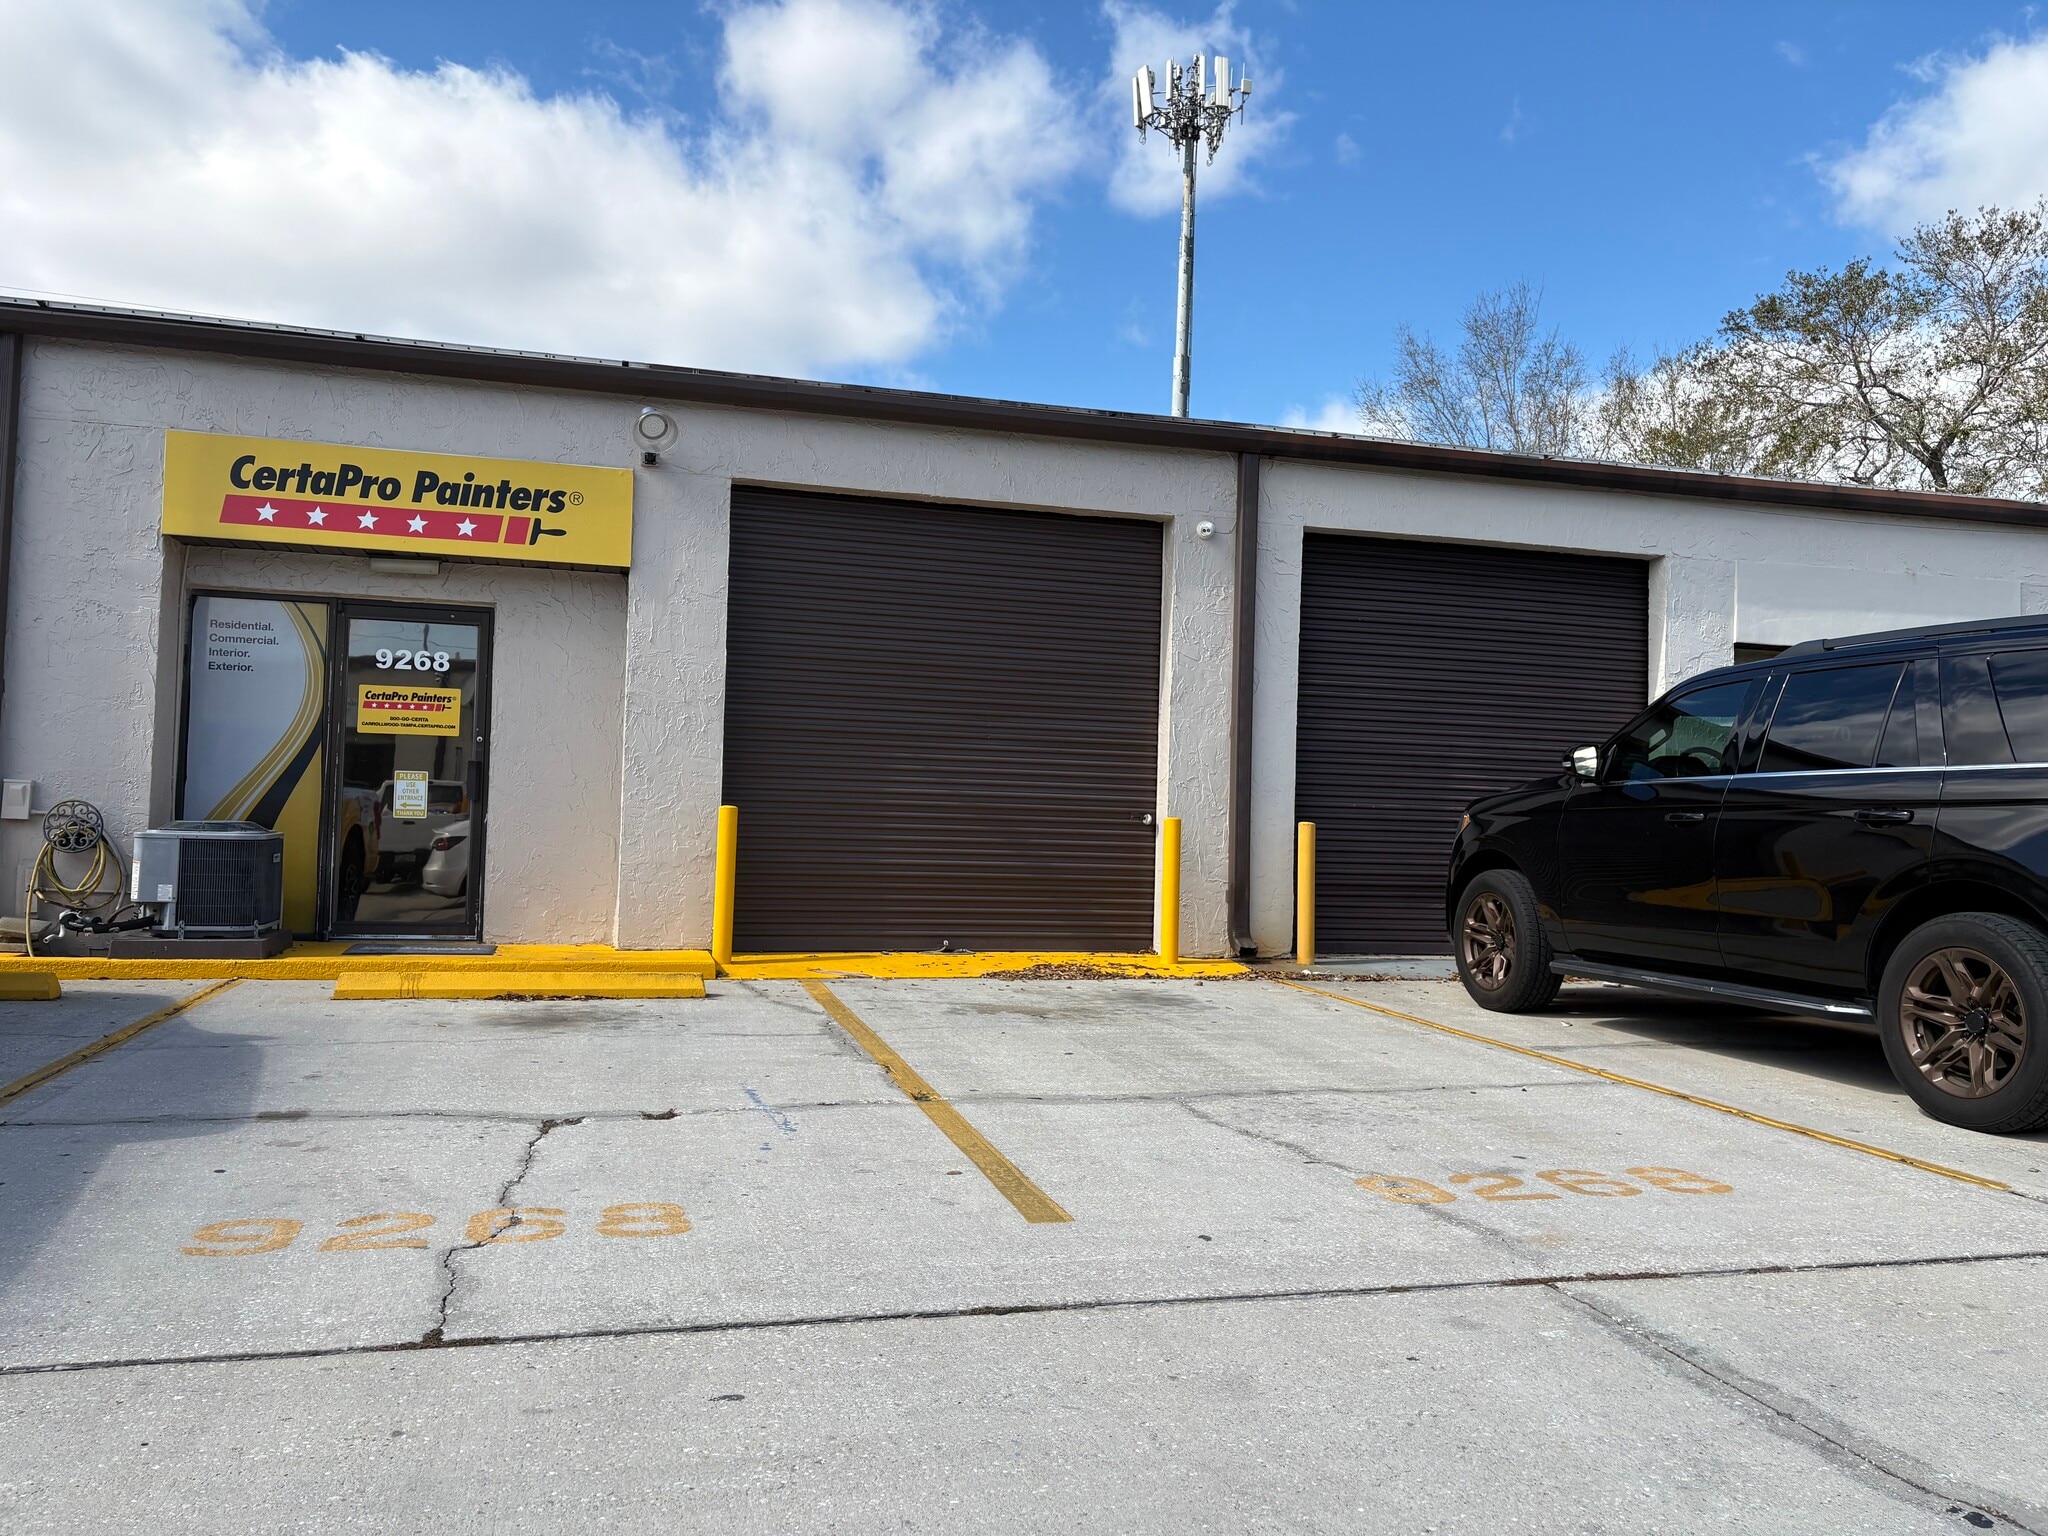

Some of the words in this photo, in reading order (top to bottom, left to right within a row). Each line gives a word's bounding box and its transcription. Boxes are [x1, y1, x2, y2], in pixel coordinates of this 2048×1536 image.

[229, 454, 401, 501] CertaPro
[210, 619, 274, 631] Residential.
[209, 633, 279, 645] Commercial.
[208, 647, 251, 658] Interior.
[375, 648, 450, 672] 9268
[208, 661, 254, 672] Exterior.
[365, 690, 409, 701] CertaPro
[1354, 1166, 1734, 1204] 9268
[178, 1203, 693, 1257] 9268
